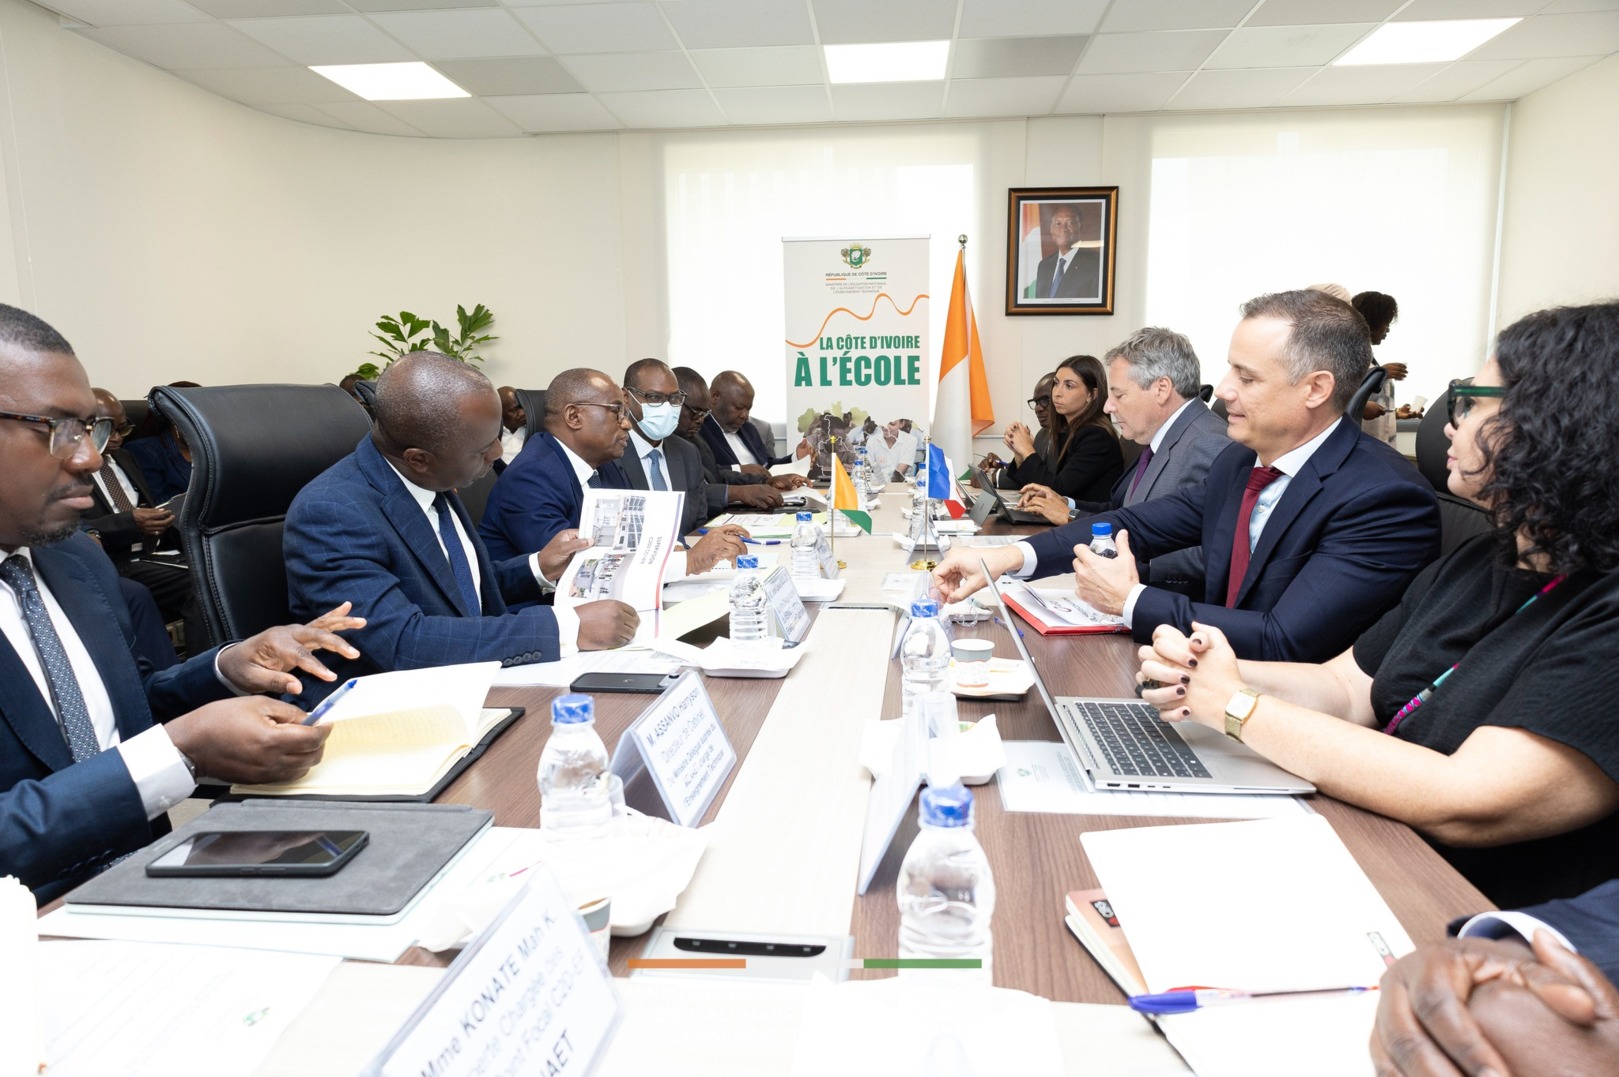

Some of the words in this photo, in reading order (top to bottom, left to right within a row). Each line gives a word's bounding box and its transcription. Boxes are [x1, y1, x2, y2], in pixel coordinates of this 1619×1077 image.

[819, 336, 834, 350] LA
[836, 333, 867, 350] CÔTE
[869, 335, 921, 350] D'IVOIRE
[794, 351, 813, 387] À
[819, 350, 921, 387] L'ÉCOLE
[460, 954, 520, 1036] KONATE
